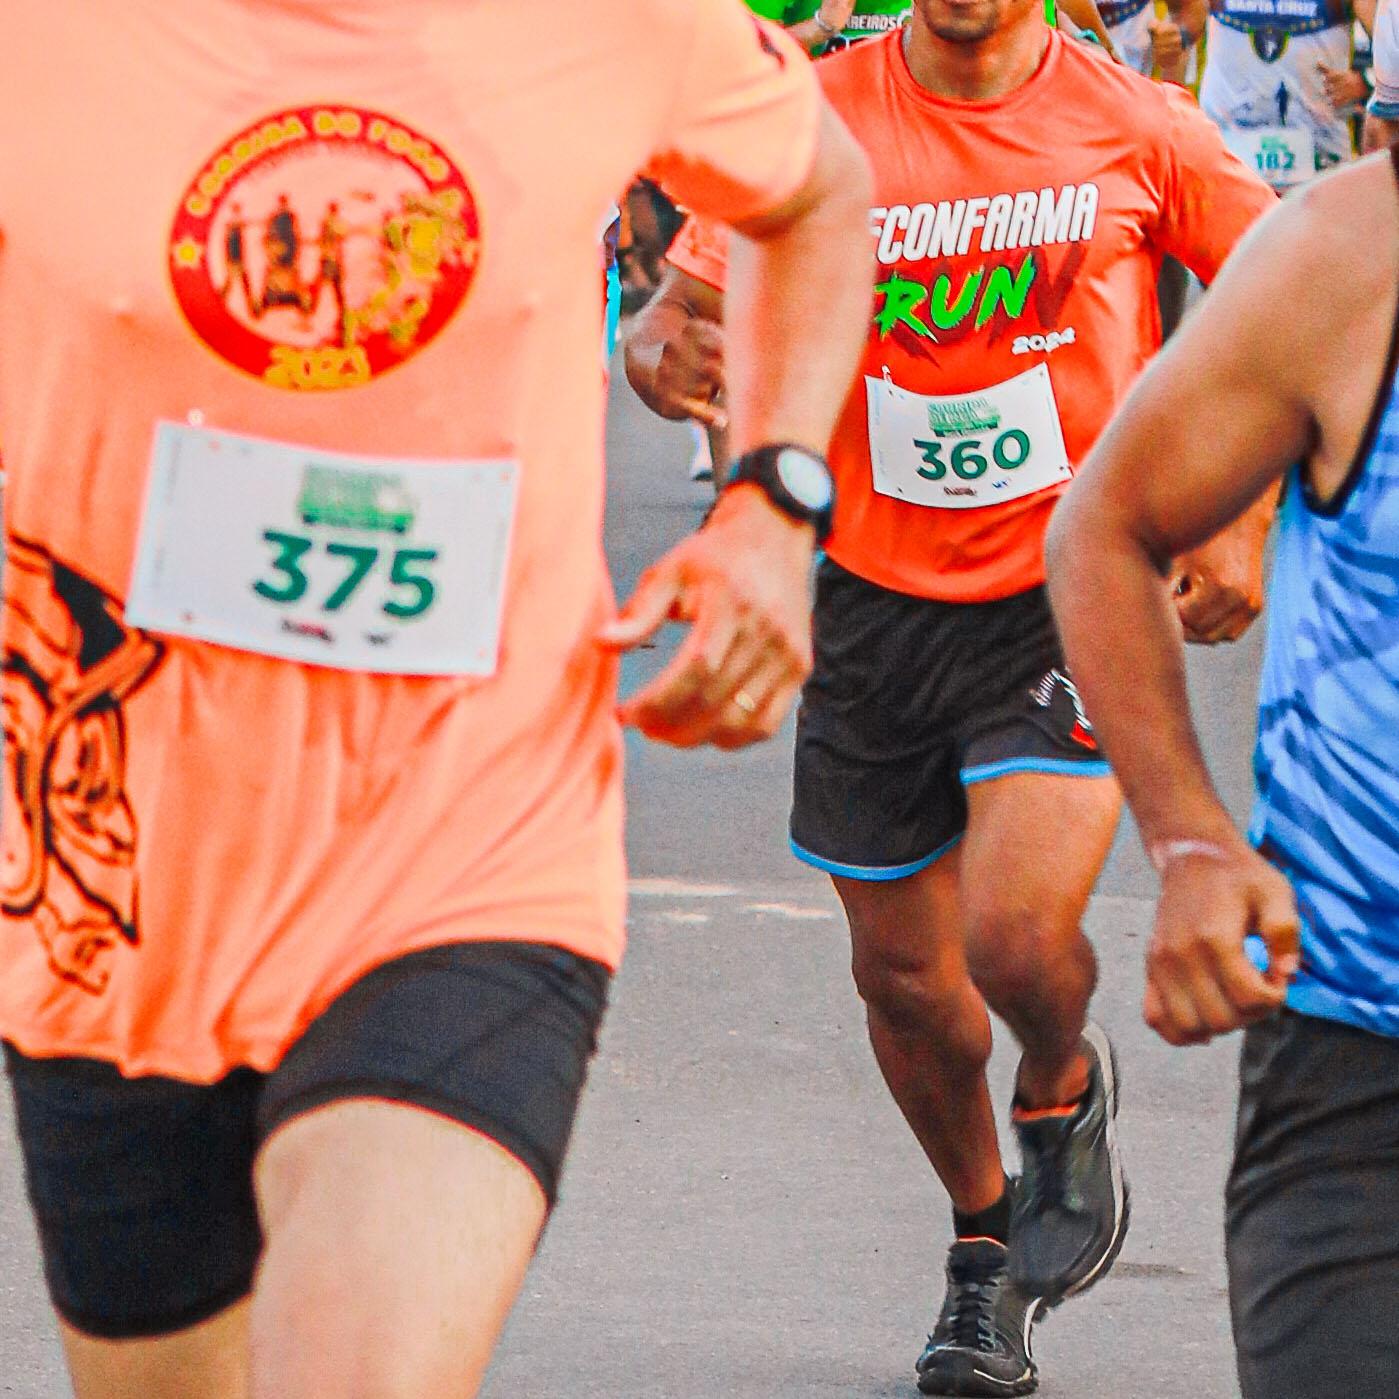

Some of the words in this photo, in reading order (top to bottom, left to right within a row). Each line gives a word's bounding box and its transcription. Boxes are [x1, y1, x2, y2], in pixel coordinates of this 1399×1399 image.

[873, 251, 1038, 344] RUN
[913, 428, 1031, 480] 360
[252, 529, 438, 617] 375
